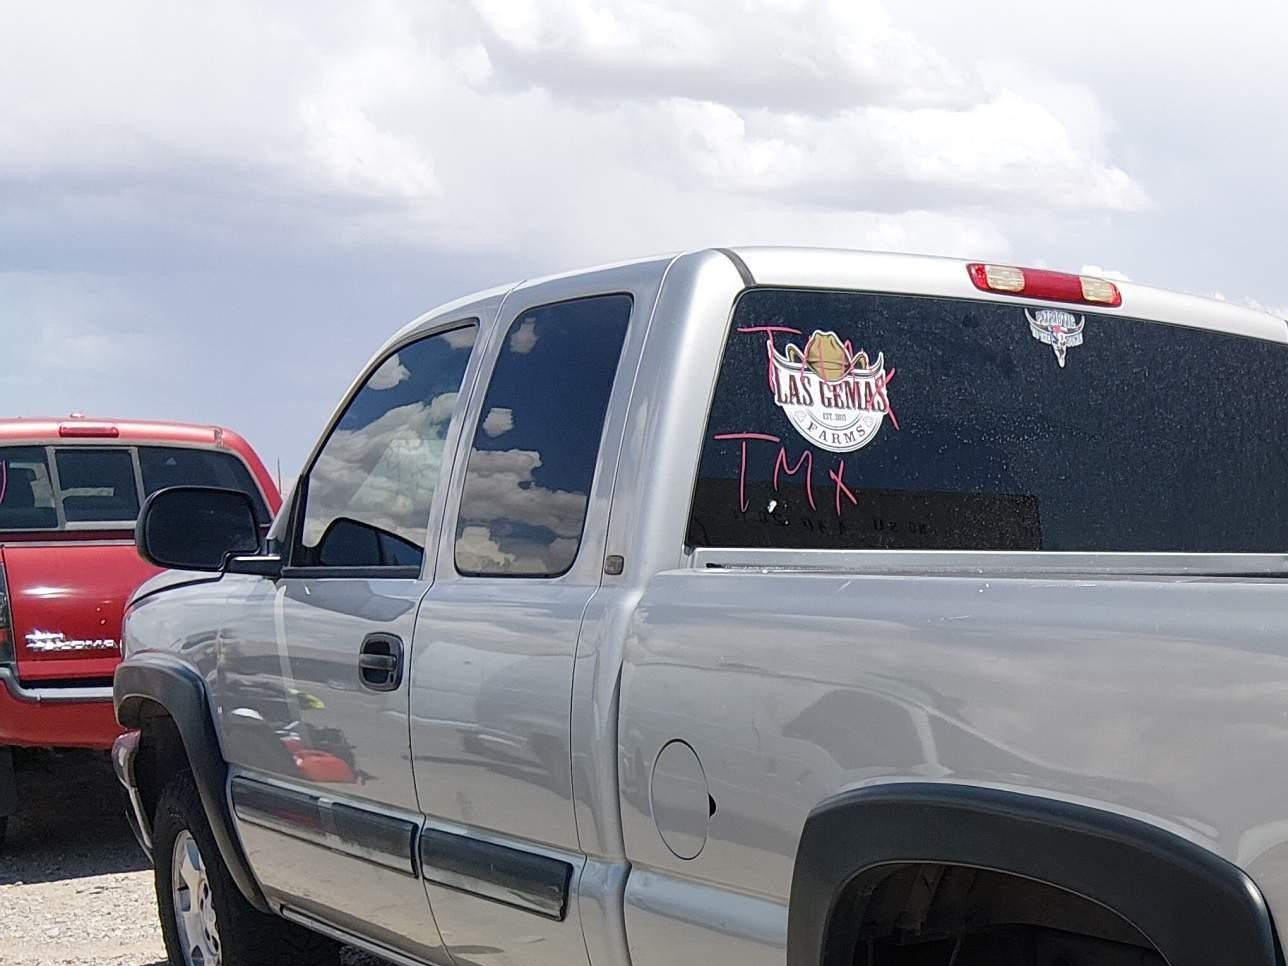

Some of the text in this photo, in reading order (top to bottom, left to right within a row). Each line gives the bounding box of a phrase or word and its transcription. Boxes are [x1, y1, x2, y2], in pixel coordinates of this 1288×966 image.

[775, 366, 888, 413] LAS GEMAS
[807, 422, 866, 445] FARMS
